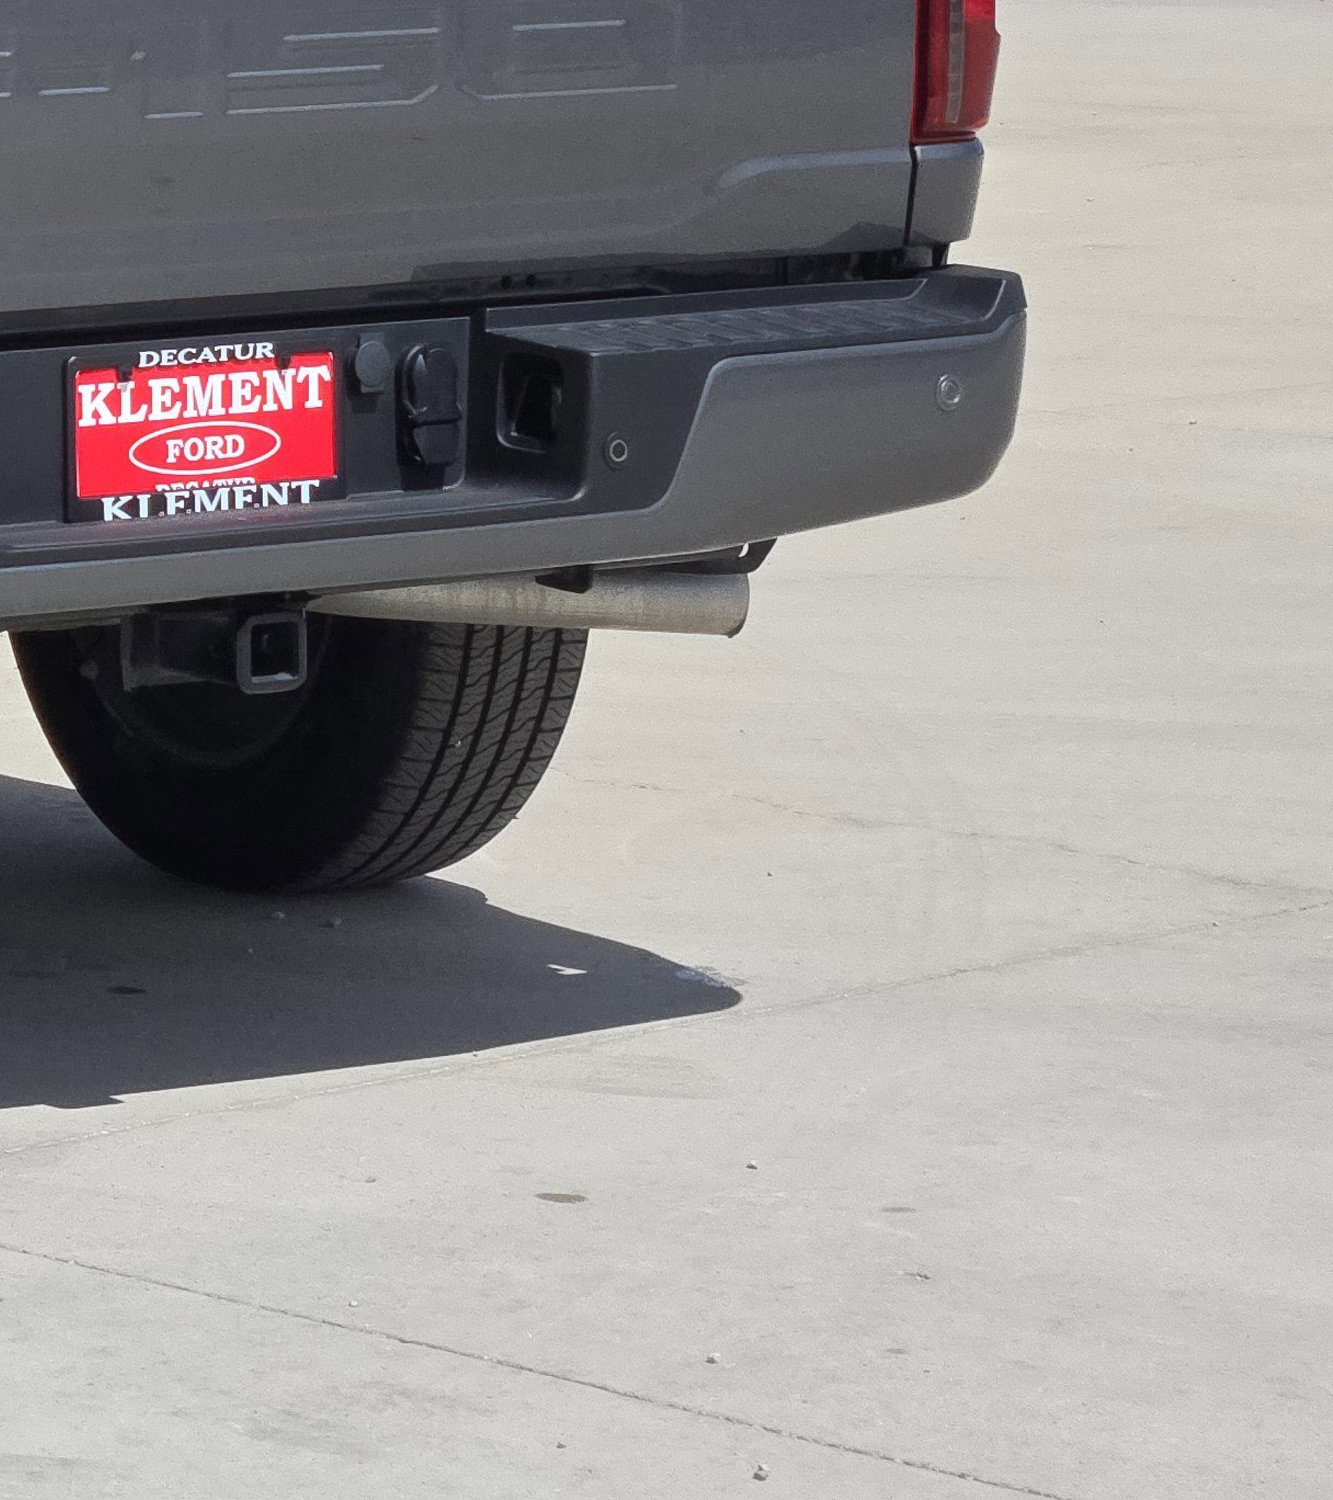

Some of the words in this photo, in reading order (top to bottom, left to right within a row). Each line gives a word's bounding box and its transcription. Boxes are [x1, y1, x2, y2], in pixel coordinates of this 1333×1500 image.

[138, 342, 276, 368] DECATUR
[78, 364, 331, 427] KLEMENT
[166, 434, 245, 464] FORD
